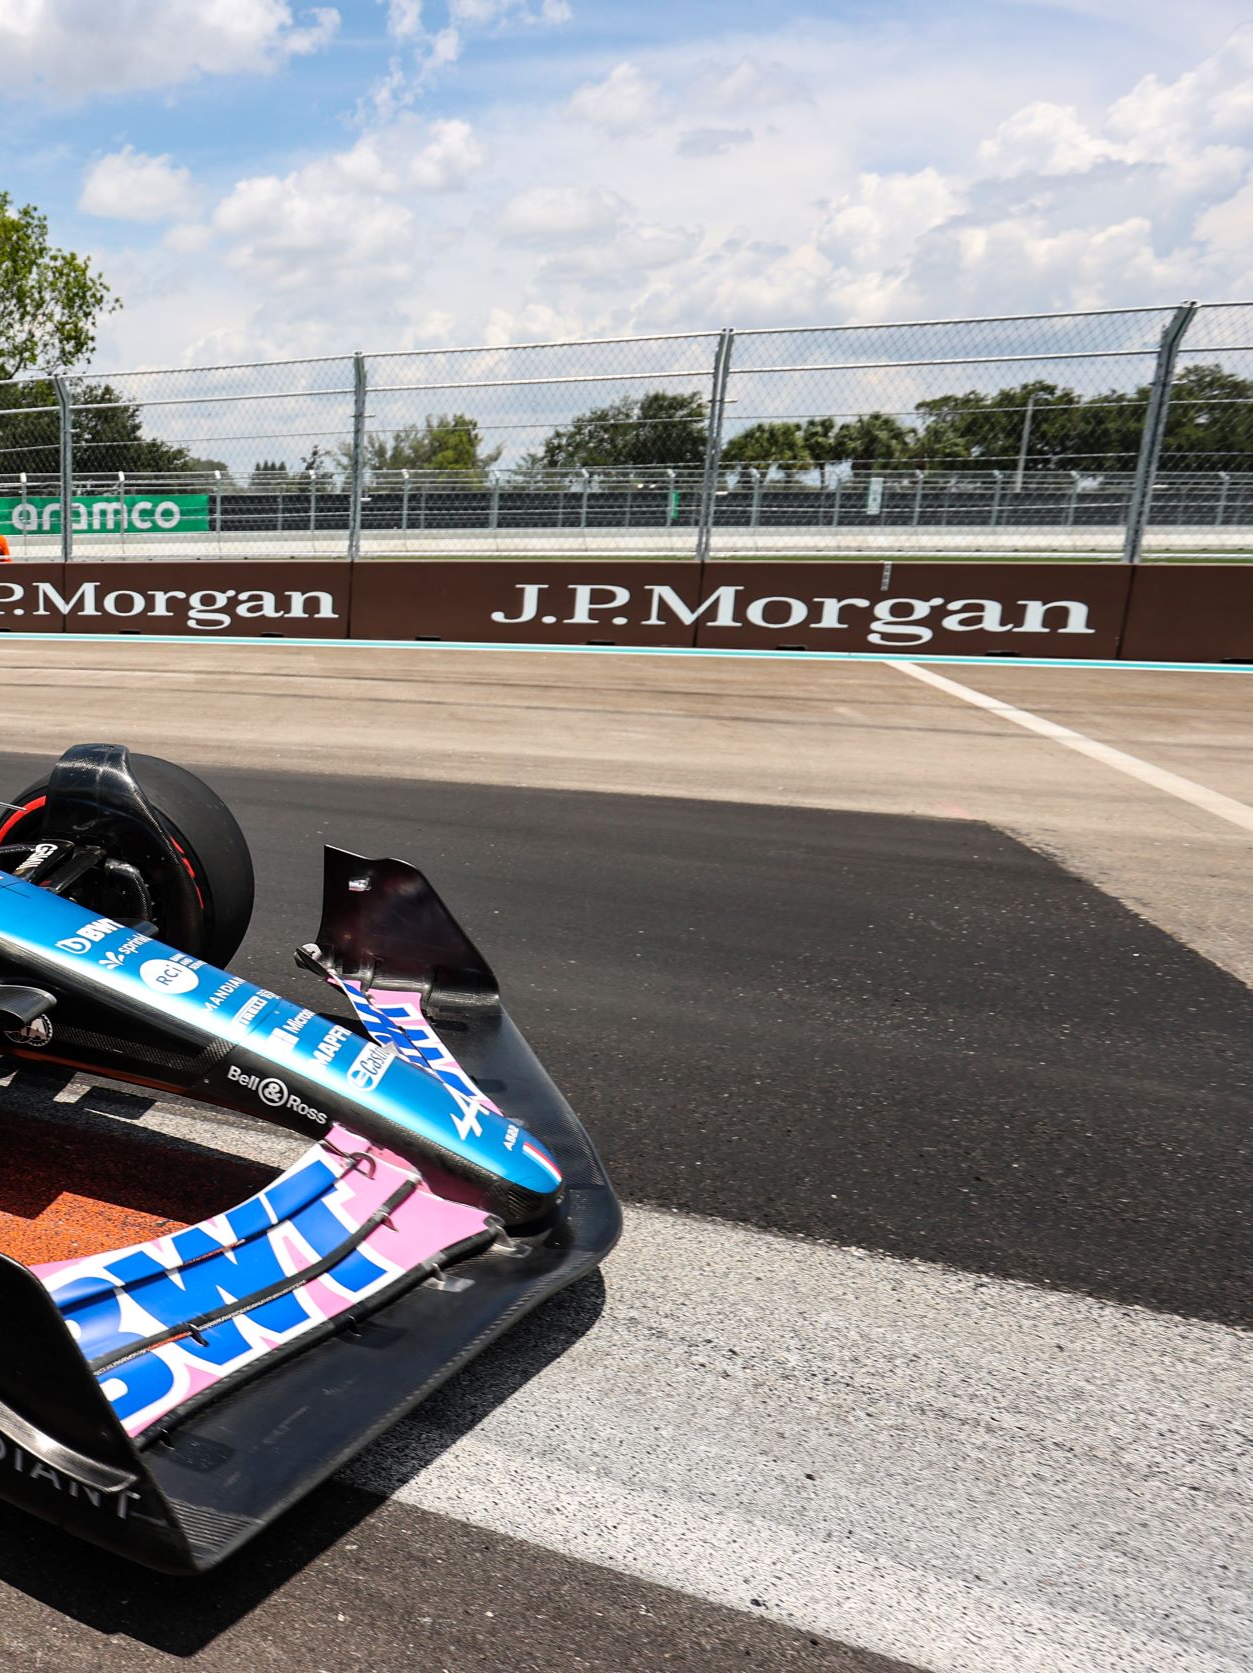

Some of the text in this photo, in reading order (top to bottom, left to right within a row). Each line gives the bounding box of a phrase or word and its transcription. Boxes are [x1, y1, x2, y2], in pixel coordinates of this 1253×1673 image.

[11, 500, 181, 531] aramco
[490, 584, 1096, 647] J.P.Morgan
[227, 1065, 328, 1125] Bell & Ross
